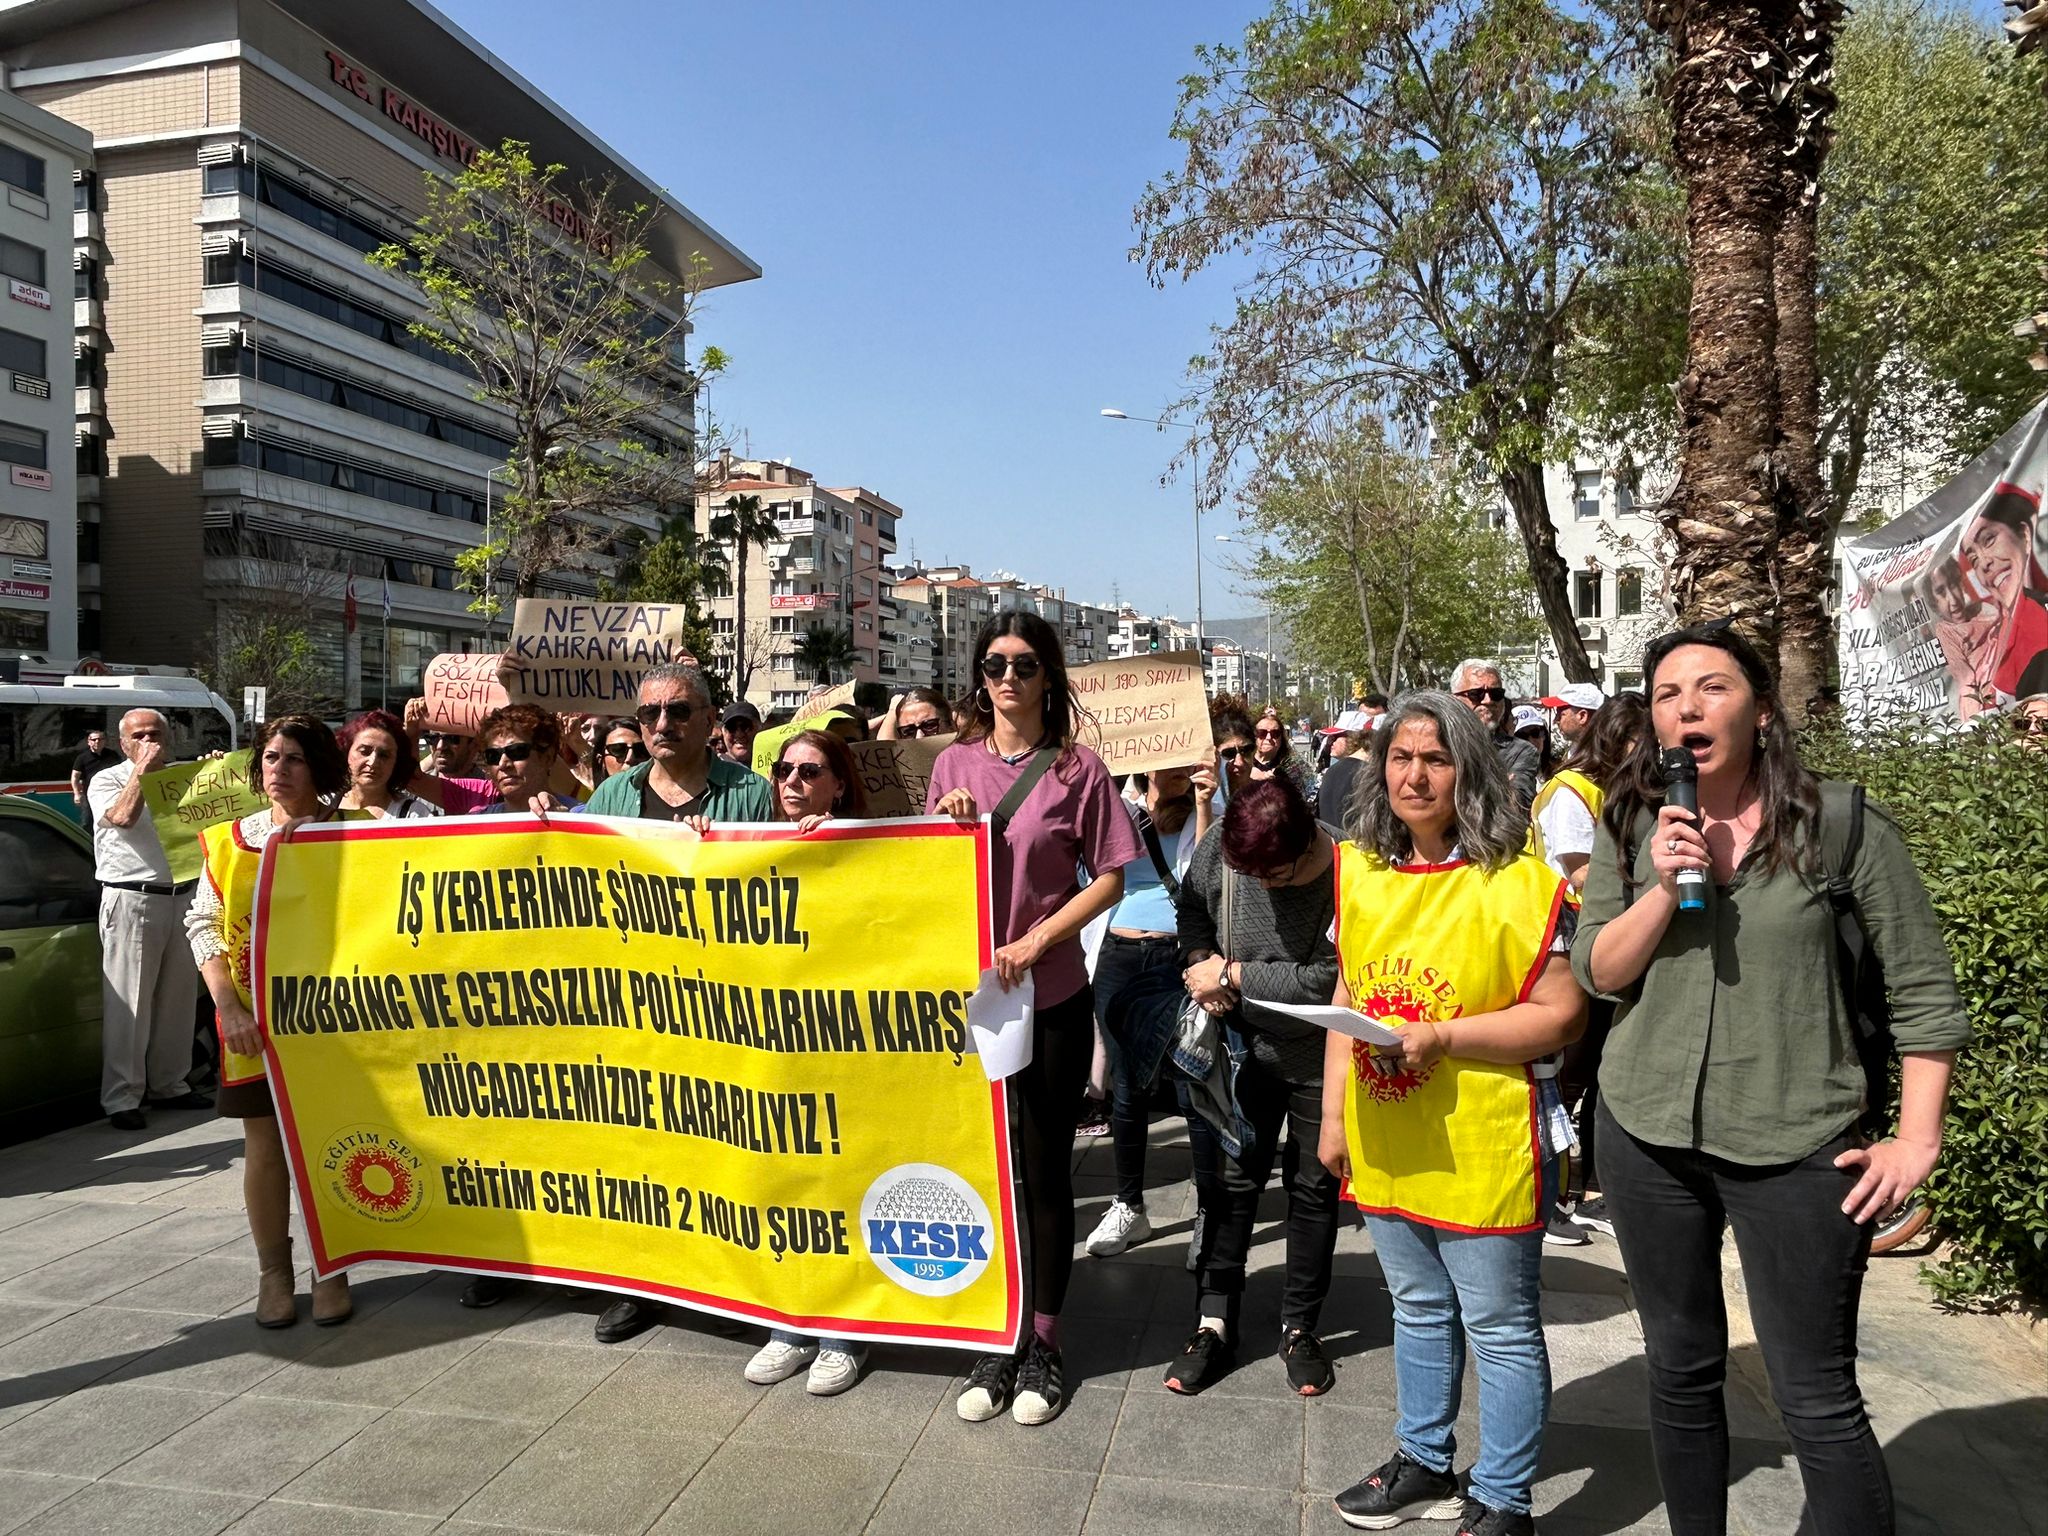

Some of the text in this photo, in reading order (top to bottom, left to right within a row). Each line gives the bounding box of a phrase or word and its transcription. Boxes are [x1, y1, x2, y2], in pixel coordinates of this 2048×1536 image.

[325, 51, 374, 105] T.C.
[544, 606, 671, 636] NEVZAT
[516, 635, 673, 666] KAHRAMAN
[518, 667, 649, 700] TUTUKLAN
[1145, 666, 1191, 687] SAYILI
[435, 699, 488, 732] ALIN
[1076, 698, 1176, 728] ÖZLEŞMESİ
[856, 747, 913, 772] KEK
[185, 764, 250, 798] YERİN
[863, 772, 929, 794] DALET
[397, 855, 809, 952] İŞ YERLERİNDE ŞİDDET, TACİZ,
[271, 964, 415, 1036] MOBBİNG
[409, 972, 459, 1029] VE
[456, 967, 629, 1028] CEZASIZLIK
[629, 965, 867, 1053] POLİTİKALARINA
[416, 1053, 657, 1131] MÜCADELEMİZDE
[659, 1071, 822, 1155] KARARLIYIZ
[324, 1131, 422, 1171] EĞİTİM SEN
[441, 1157, 536, 1211] EĞİTİM
[541, 1171, 591, 1218] SEN
[596, 1168, 671, 1229] İZMİR
[678, 1187, 694, 1232] 2
[699, 1190, 761, 1251] NOLU
[767, 1205, 850, 1263] ŞUBE
[868, 1220, 988, 1261] KESK
[913, 1263, 944, 1277] 1995
